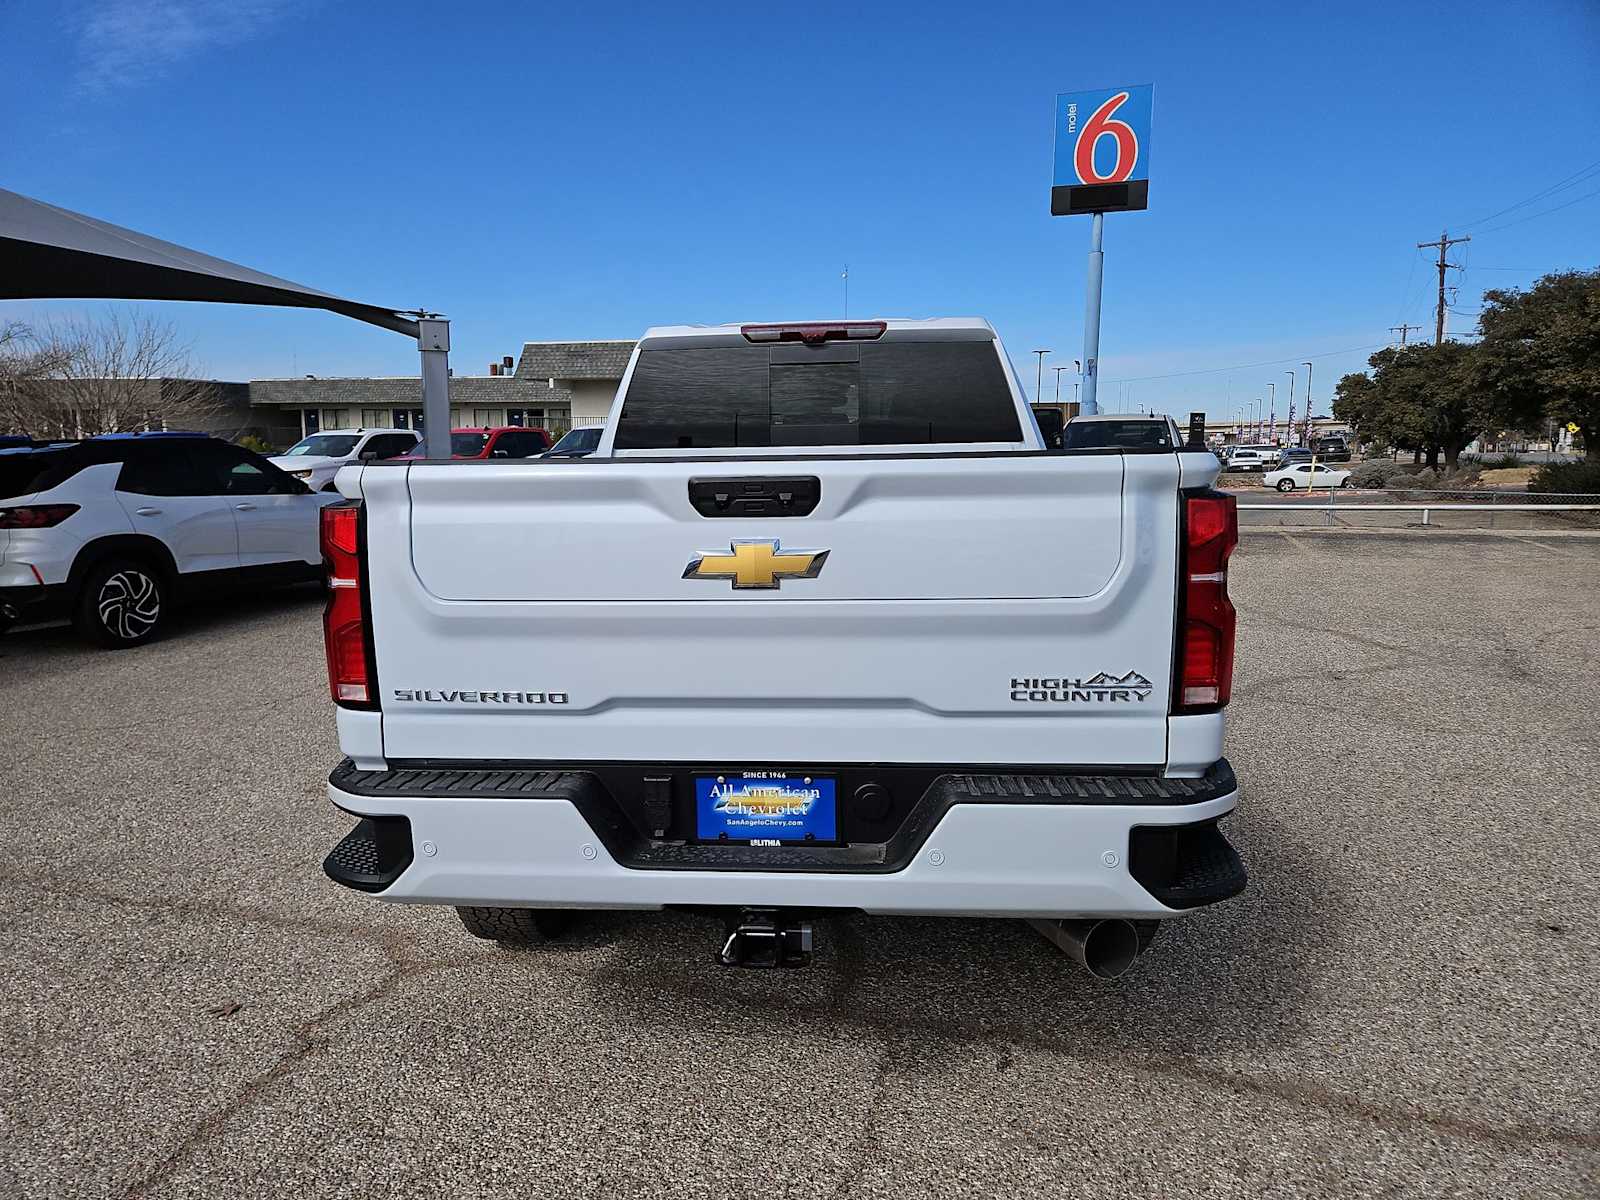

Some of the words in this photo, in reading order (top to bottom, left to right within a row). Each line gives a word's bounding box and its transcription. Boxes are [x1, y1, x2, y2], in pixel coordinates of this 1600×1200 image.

[1068, 103, 1077, 133] motel
[1074, 92, 1138, 184] 6
[1010, 678, 1083, 689] HIGH
[394, 689, 569, 704] SILVERADO
[1010, 690, 1152, 702] COUNTRY
[710, 784, 733, 798] All
[741, 785, 820, 798] American
[725, 801, 808, 815] Chevrolet
[726, 819, 803, 827] SanAngeloChevy.com
